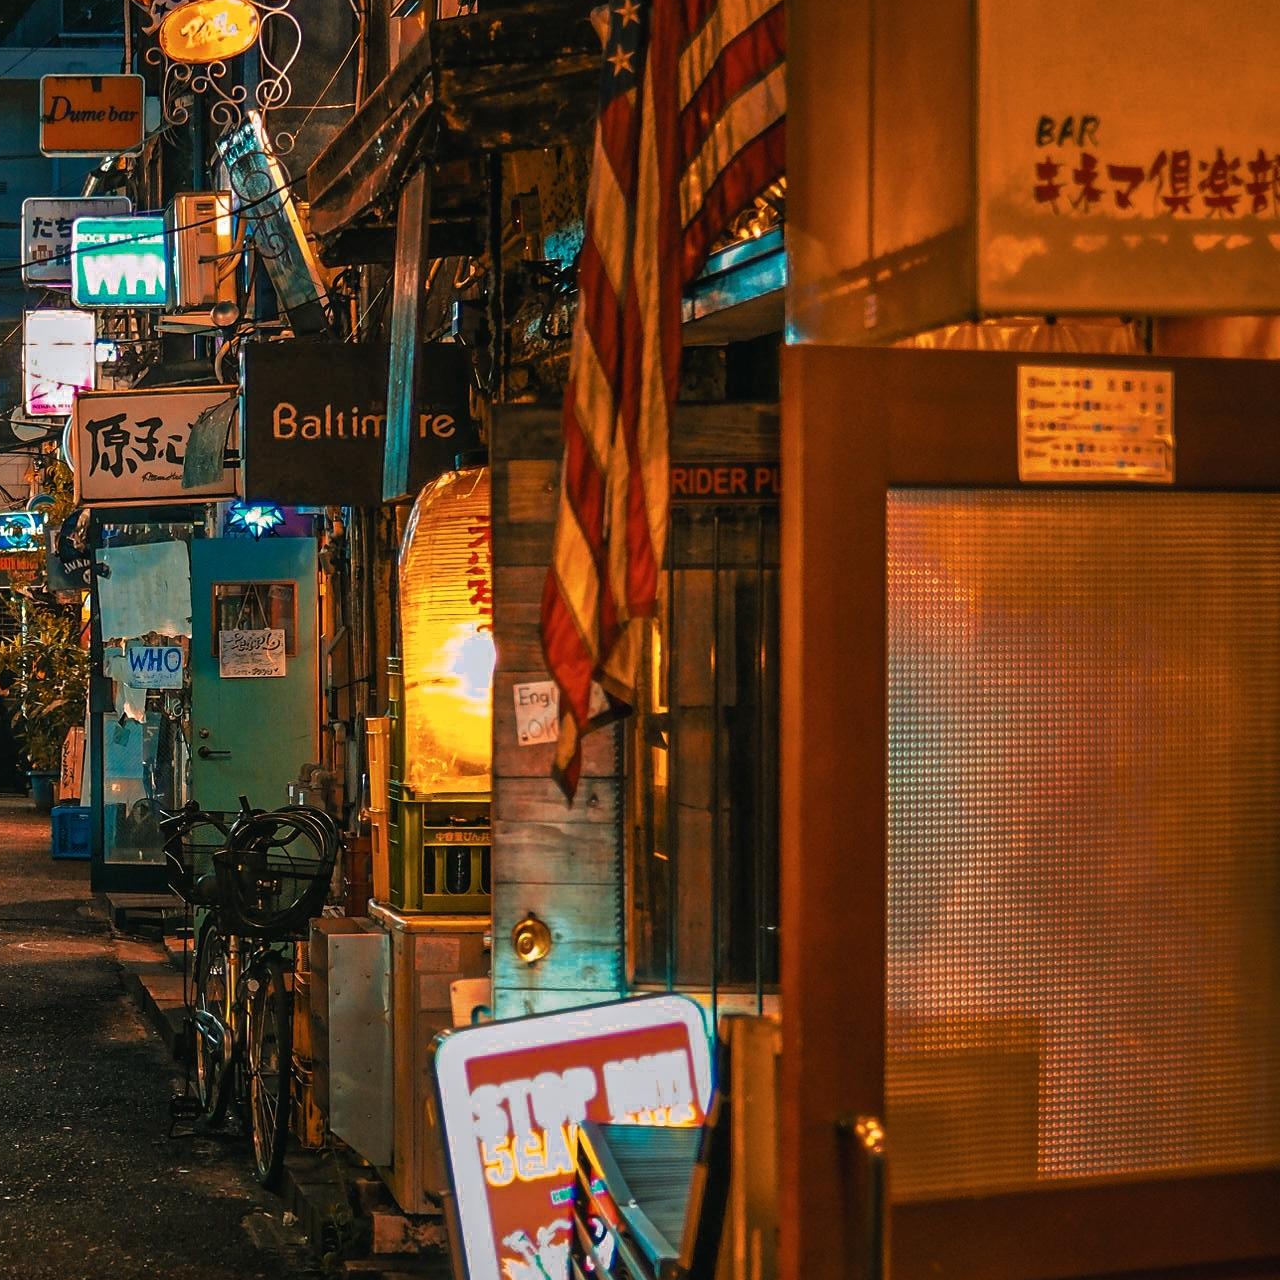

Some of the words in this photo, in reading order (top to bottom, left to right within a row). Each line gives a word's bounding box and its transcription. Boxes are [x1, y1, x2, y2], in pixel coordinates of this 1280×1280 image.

[108, 105, 138, 123] bar
[1035, 114, 1101, 148] BAR
[272, 401, 457, 440] Baltimre
[671, 466, 748, 496] RIDER
[129, 647, 182, 673] WHO
